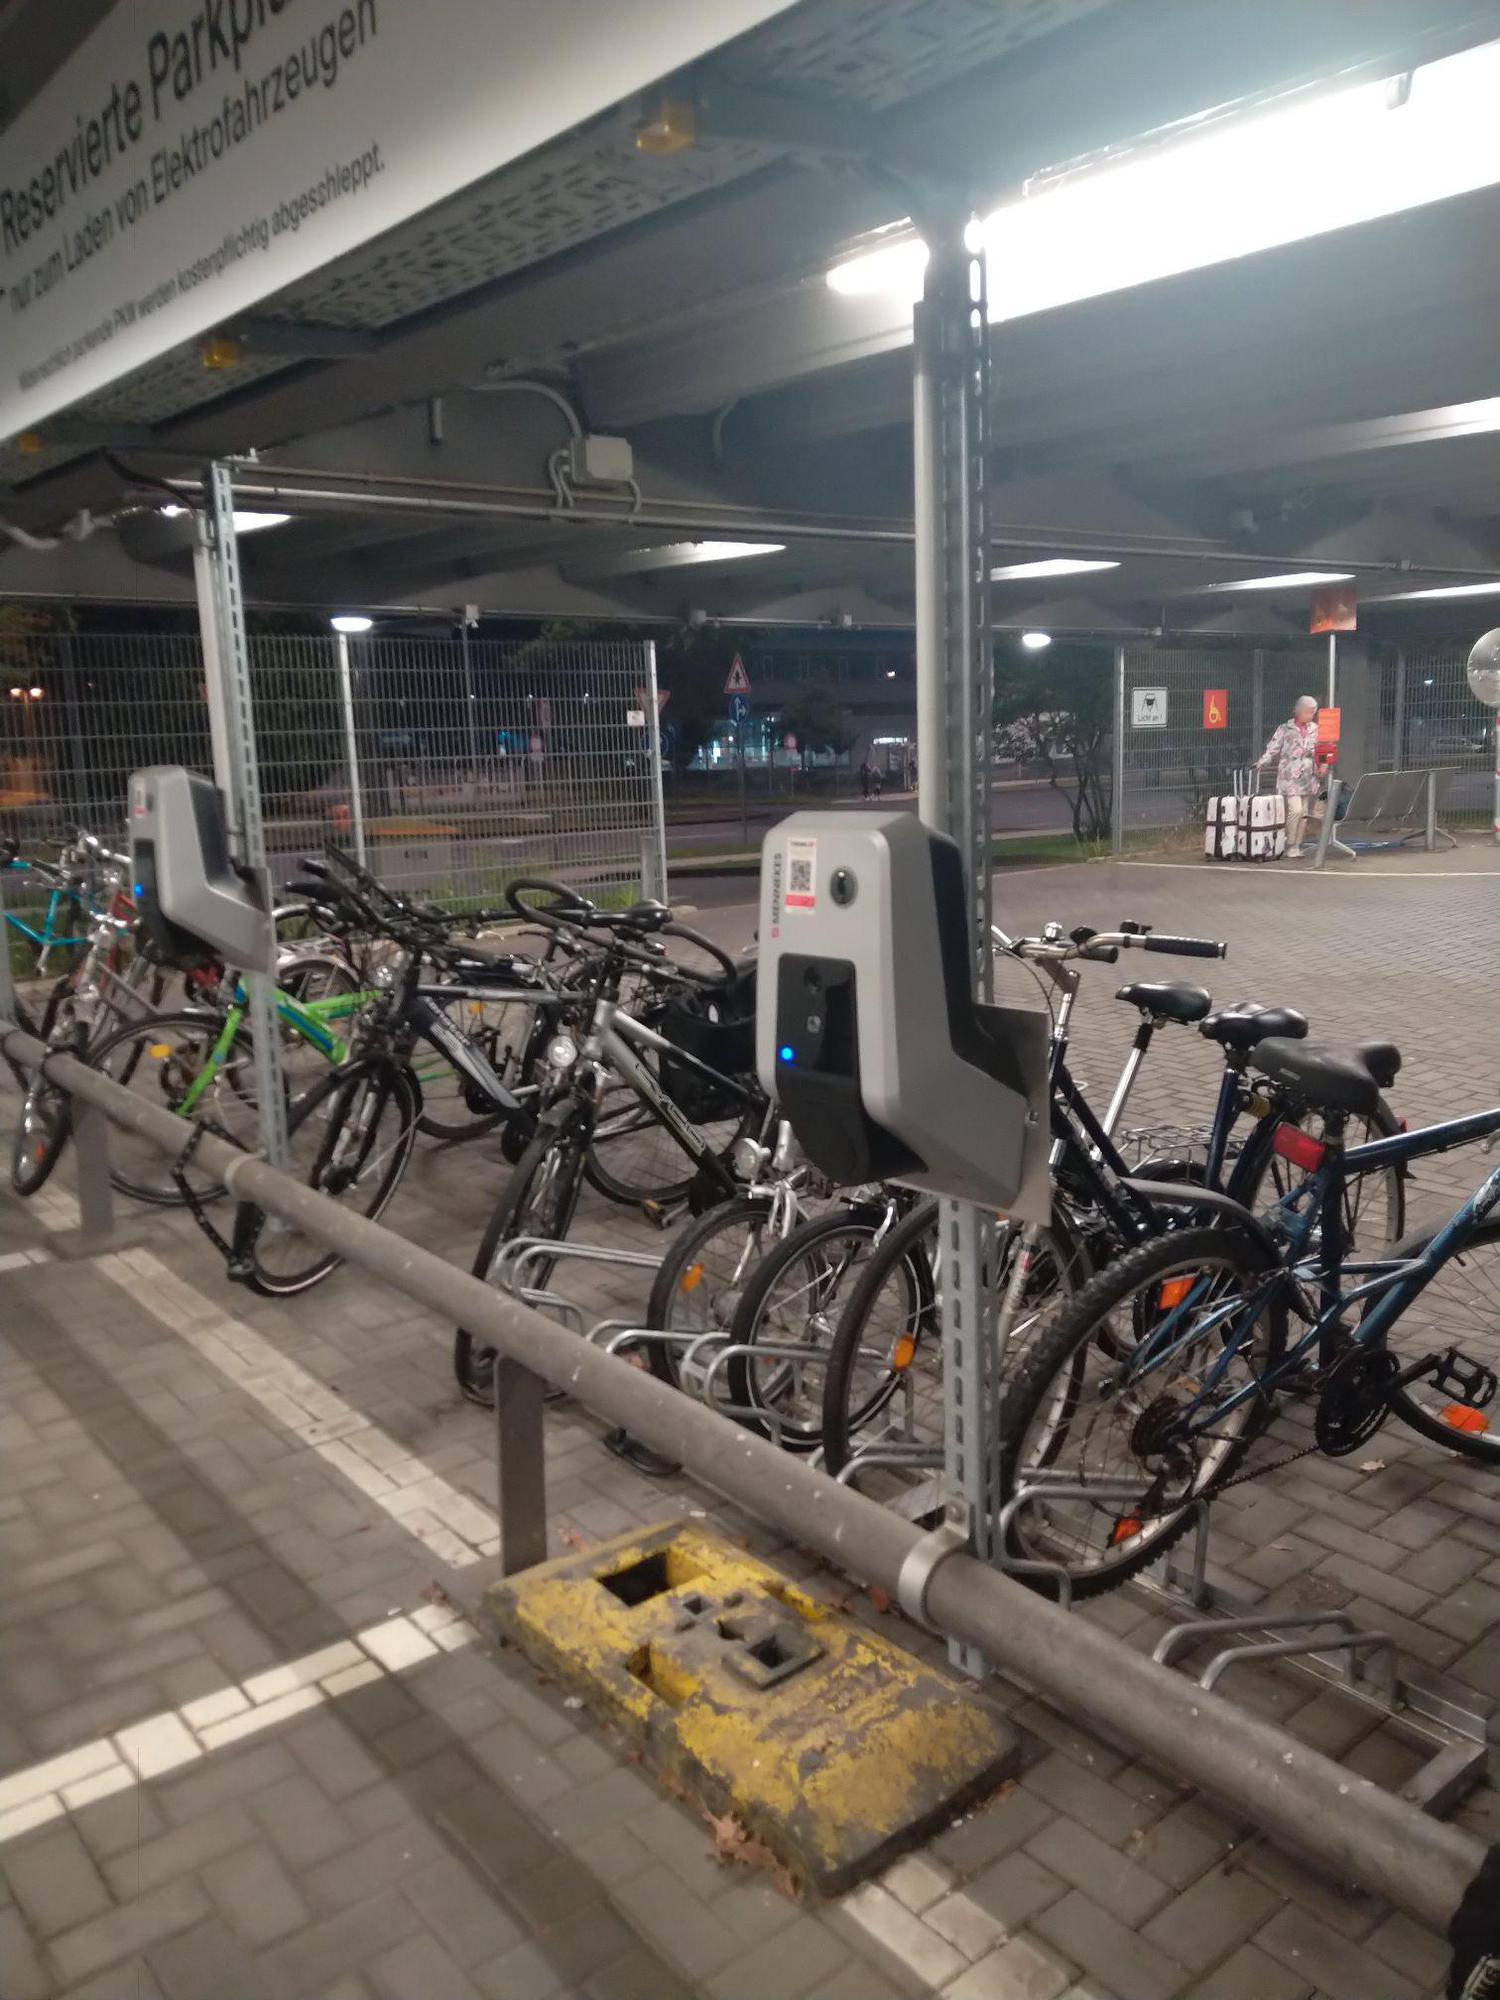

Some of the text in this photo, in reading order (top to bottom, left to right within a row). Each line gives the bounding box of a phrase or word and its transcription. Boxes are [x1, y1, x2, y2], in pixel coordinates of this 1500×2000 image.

[0, 80, 143, 255] Reservierte
[63, 213, 114, 272] Laden
[114, 178, 149, 232] von
[151, 0, 377, 204] Elektrofahrzeugen
[271, 141, 385, 236] abgeschleppt.
